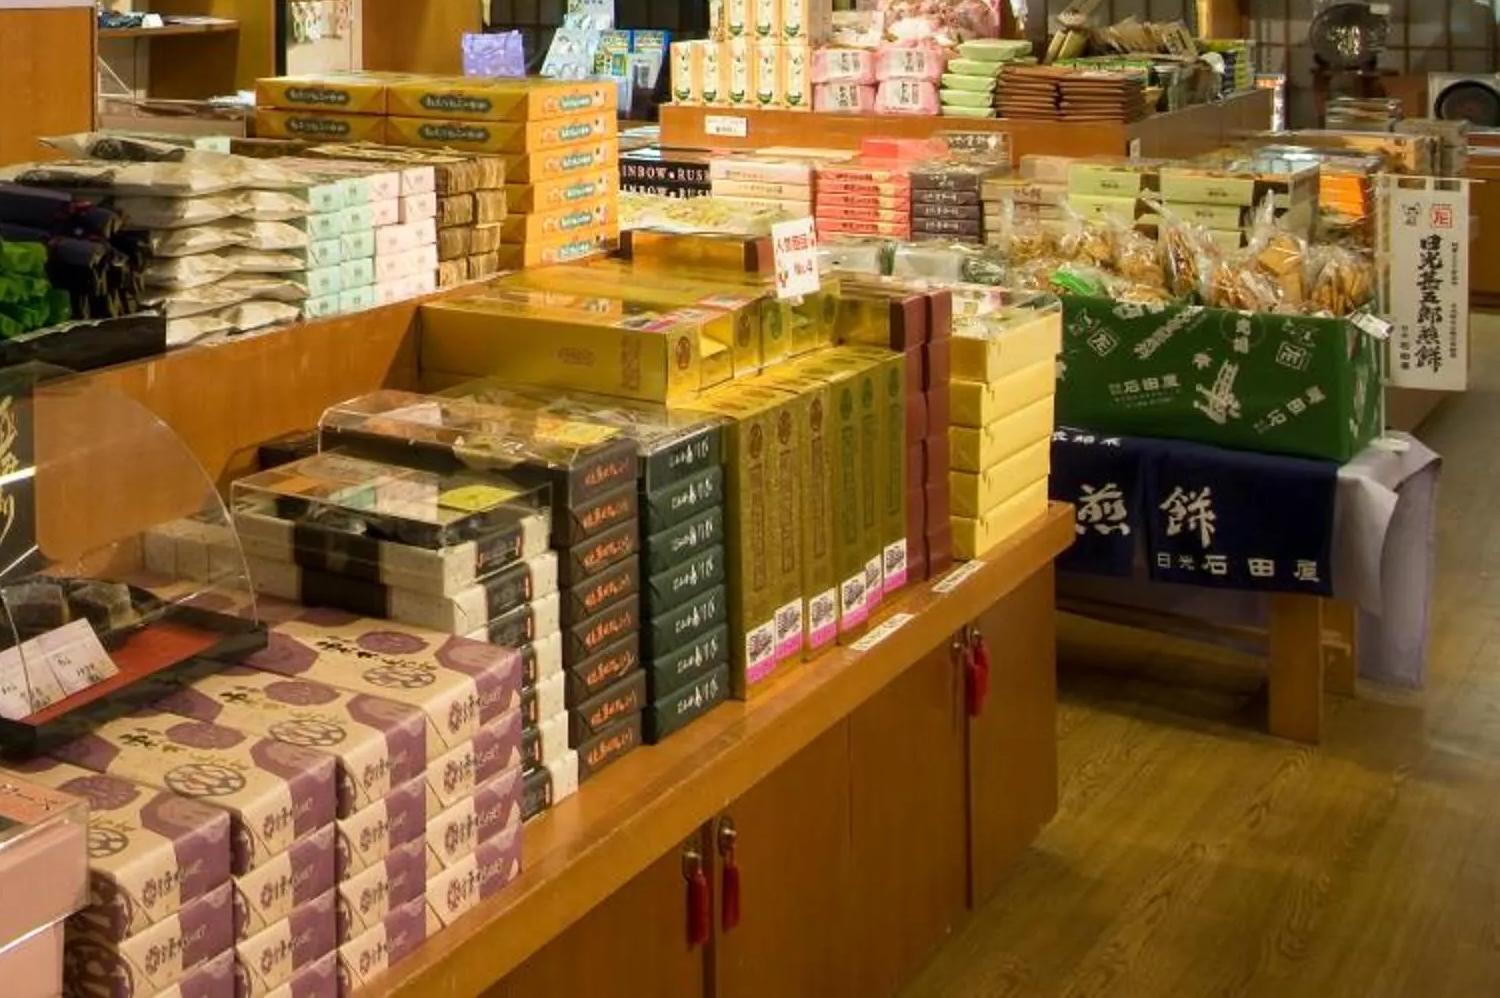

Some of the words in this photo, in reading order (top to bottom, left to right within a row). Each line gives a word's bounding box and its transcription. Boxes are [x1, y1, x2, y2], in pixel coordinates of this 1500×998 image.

[1415, 233, 1443, 373] 日光甚五郎煎餅
